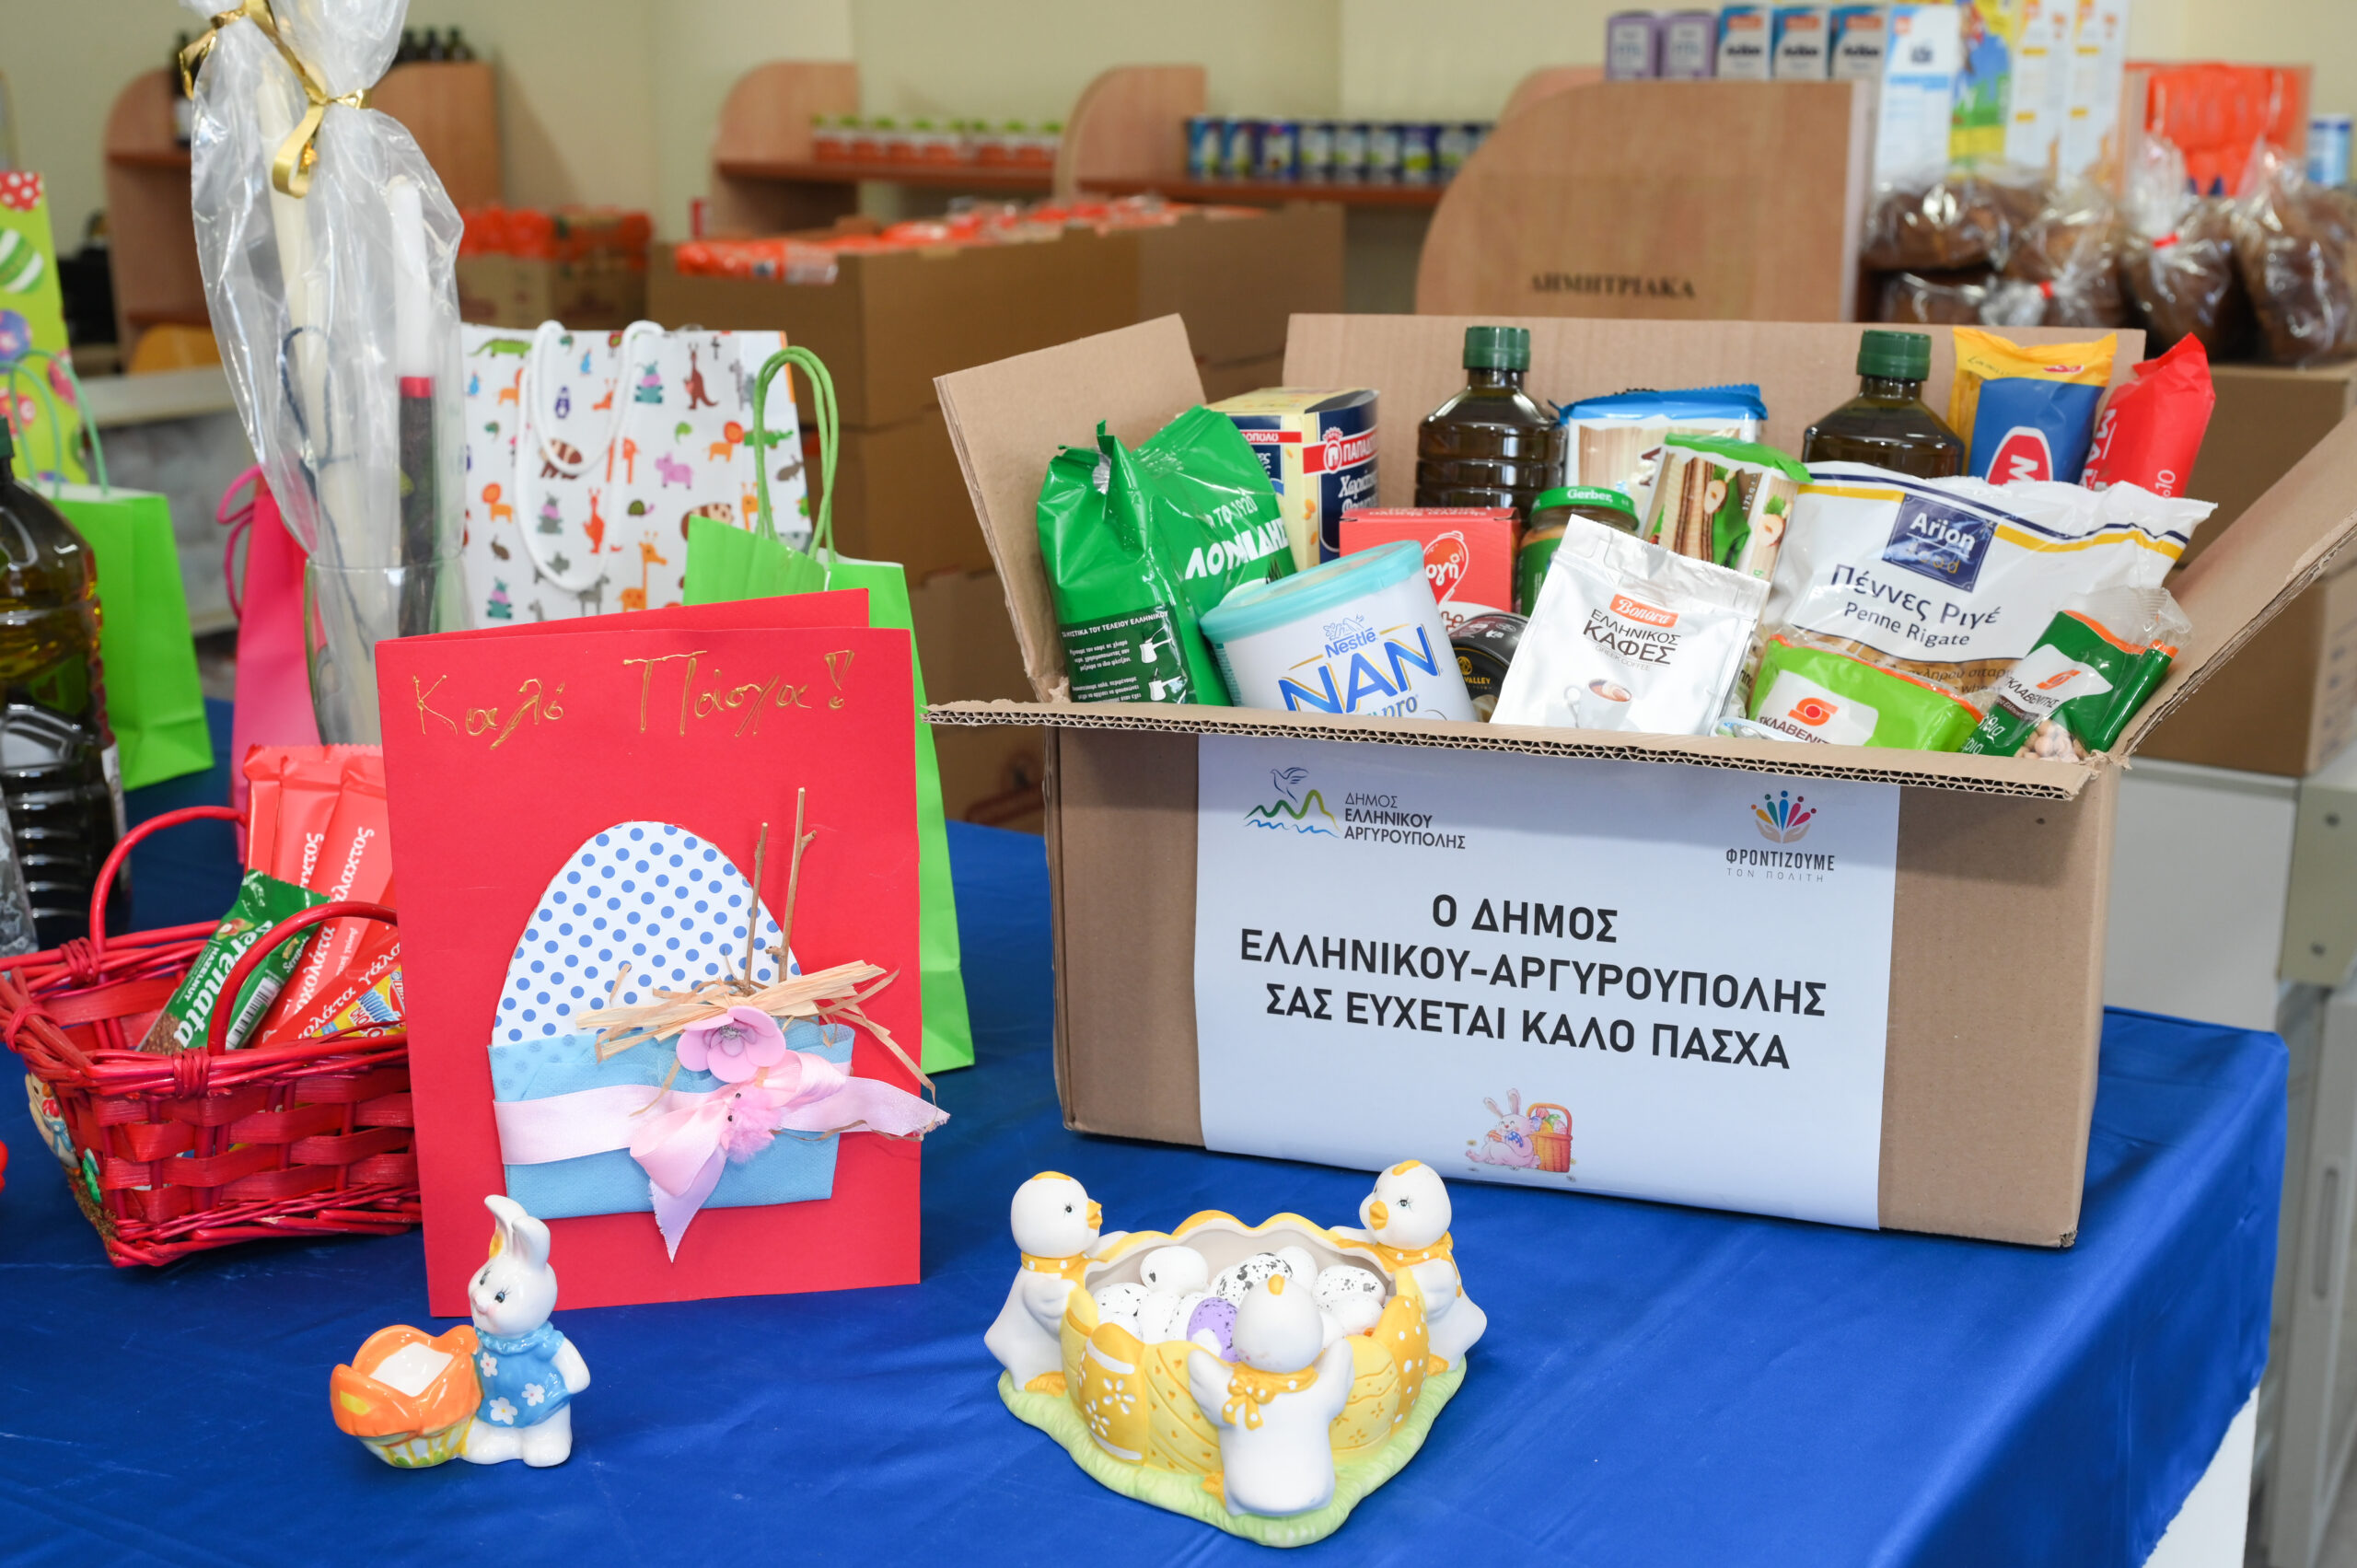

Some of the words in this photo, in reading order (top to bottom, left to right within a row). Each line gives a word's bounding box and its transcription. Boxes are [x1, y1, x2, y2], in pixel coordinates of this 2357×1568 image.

[1230, 495, 1258, 517] 1920
[1617, 598, 1672, 624] Bonora
[1830, 563, 1932, 621] Πέννες
[1939, 601, 2001, 630] Ριγέ
[1089, 626, 1101, 634] ΤΟΥ
[1102, 620, 1129, 631] ΤΕΛΕΙΟΥ
[1131, 610, 1168, 625] ΕΛΛΗΝΙΚΟΥ
[1591, 609, 1681, 645] ΕΛΛΗΝΙΚΟΣ
[1844, 602, 1901, 633] Penne
[1906, 623, 1970, 647] Rigate
[1325, 627, 1376, 658] Nestlé
[1584, 620, 1676, 665] ΚΑΦΕΣ
[1278, 623, 1441, 714] NAN
[1464, 676, 1491, 685] VALLEY
[2006, 676, 2060, 709] ΚΛΑΒΕΝΙΤΗΣ
[412, 674, 565, 749] Καλό
[1345, 792, 1398, 808] ΔΗΜΟΣ
[1345, 807, 1433, 828] ΕΛΛΗΝΙΚΟΥ
[1344, 826, 1466, 849] ΑΡΓΥΡΟΥΠΟΛΗΣ
[1726, 848, 1835, 871] ΦΡΟΝΤΙΖΟΥΜΕ
[1726, 868, 1754, 877] ΤΟΝ
[1766, 871, 1824, 882] ΠΟΛΙΤΗ
[1433, 894, 1457, 927] Ο
[1471, 899, 1619, 943] ΔΗΜΟΣ
[184, 947, 220, 1002] HAZELNUT
[295, 926, 335, 1014] οκολάτα
[1240, 928, 1828, 1017] ΕΛΛΗΝΙΚΟΥ-ΑΡΓΥΡΟΥΠΟΛΗΣ
[1266, 983, 1333, 1021] ΣΑΣ
[1346, 991, 1505, 1040] ΕΥΧΕΤΑΙ
[1522, 1009, 1635, 1053] ΚΑΛΟ
[1652, 1021, 1790, 1070] ΠΑΣΧΑ
